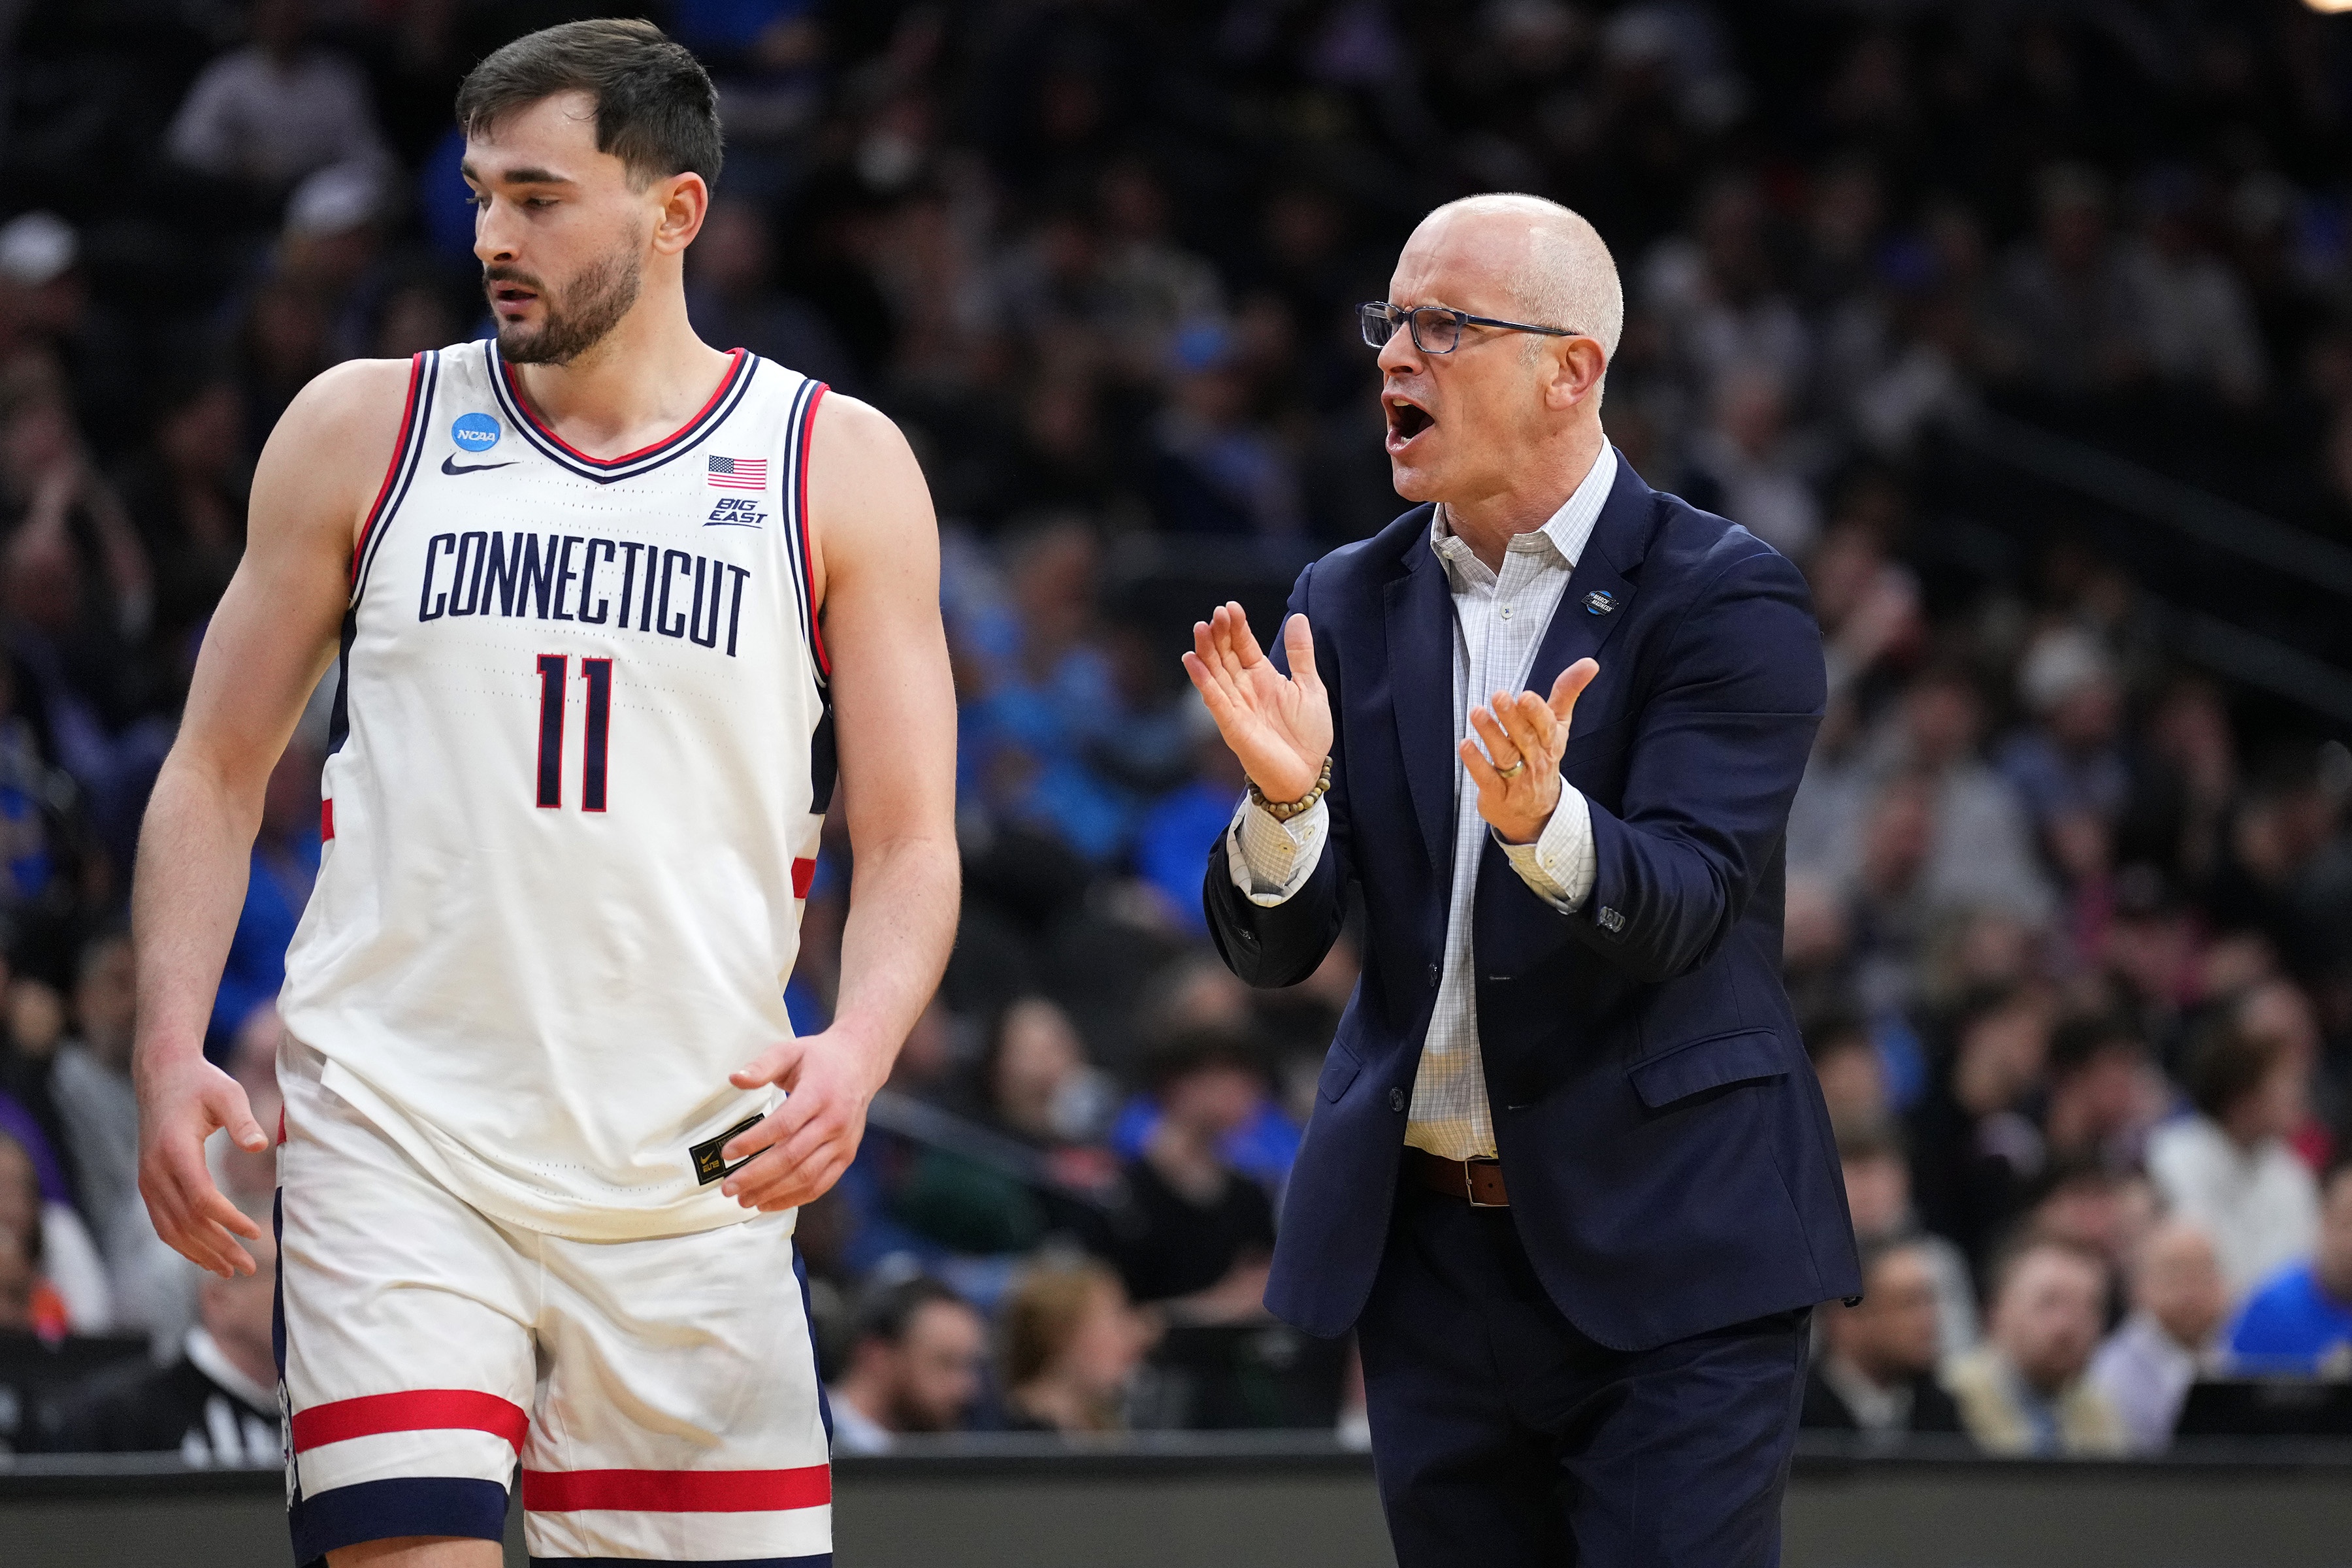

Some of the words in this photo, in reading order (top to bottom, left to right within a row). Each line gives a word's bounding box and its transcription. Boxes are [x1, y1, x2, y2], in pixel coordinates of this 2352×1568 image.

[457, 429, 496, 443] NCAA
[716, 498, 758, 511] BIG
[708, 511, 768, 524] EAST
[419, 531, 751, 657] CONNECTICUT
[1593, 594, 1610, 605] MARCH
[1592, 599, 1612, 612] MADNESS
[536, 653, 613, 812] 11
